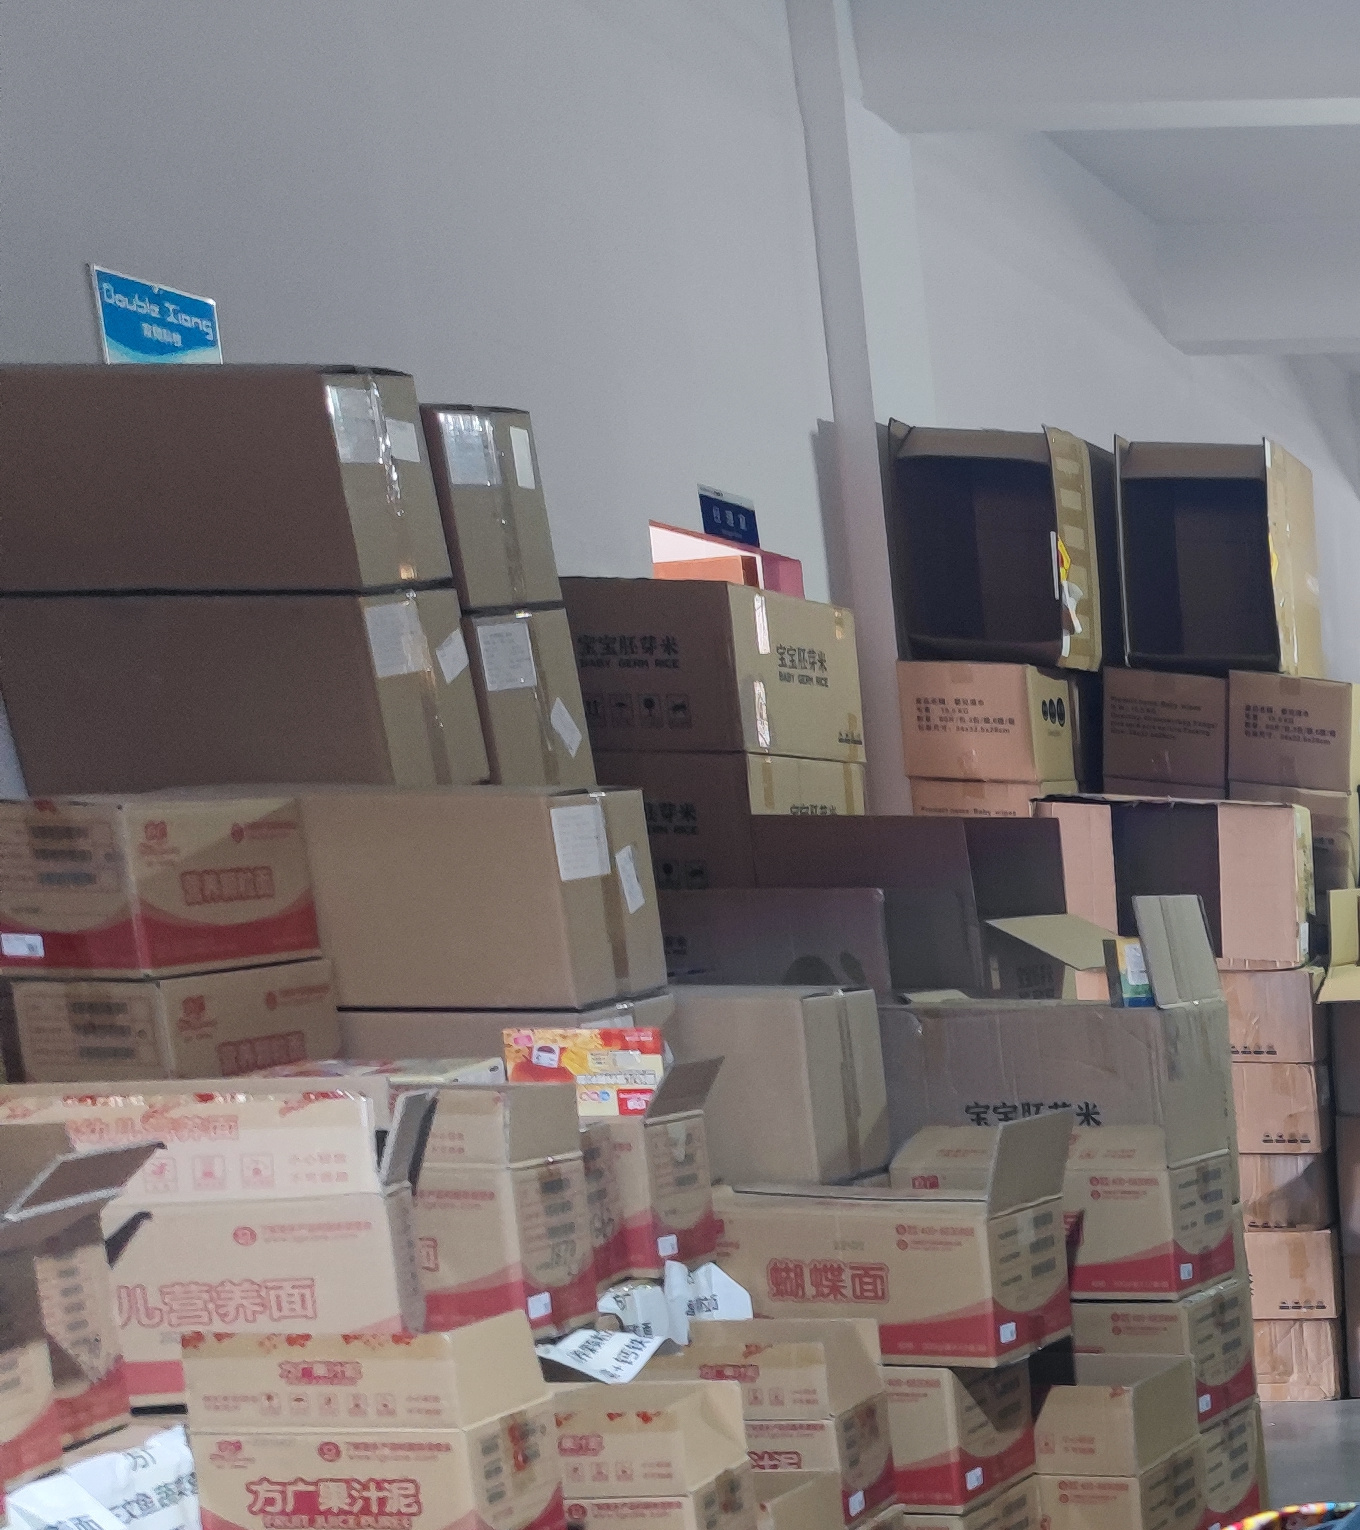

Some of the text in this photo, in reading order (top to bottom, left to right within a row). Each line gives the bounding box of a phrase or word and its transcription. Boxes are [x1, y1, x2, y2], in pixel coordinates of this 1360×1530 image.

[767, 1258, 889, 1303] 蝴蝶面
[247, 1478, 421, 1515] 方广果汁泥
